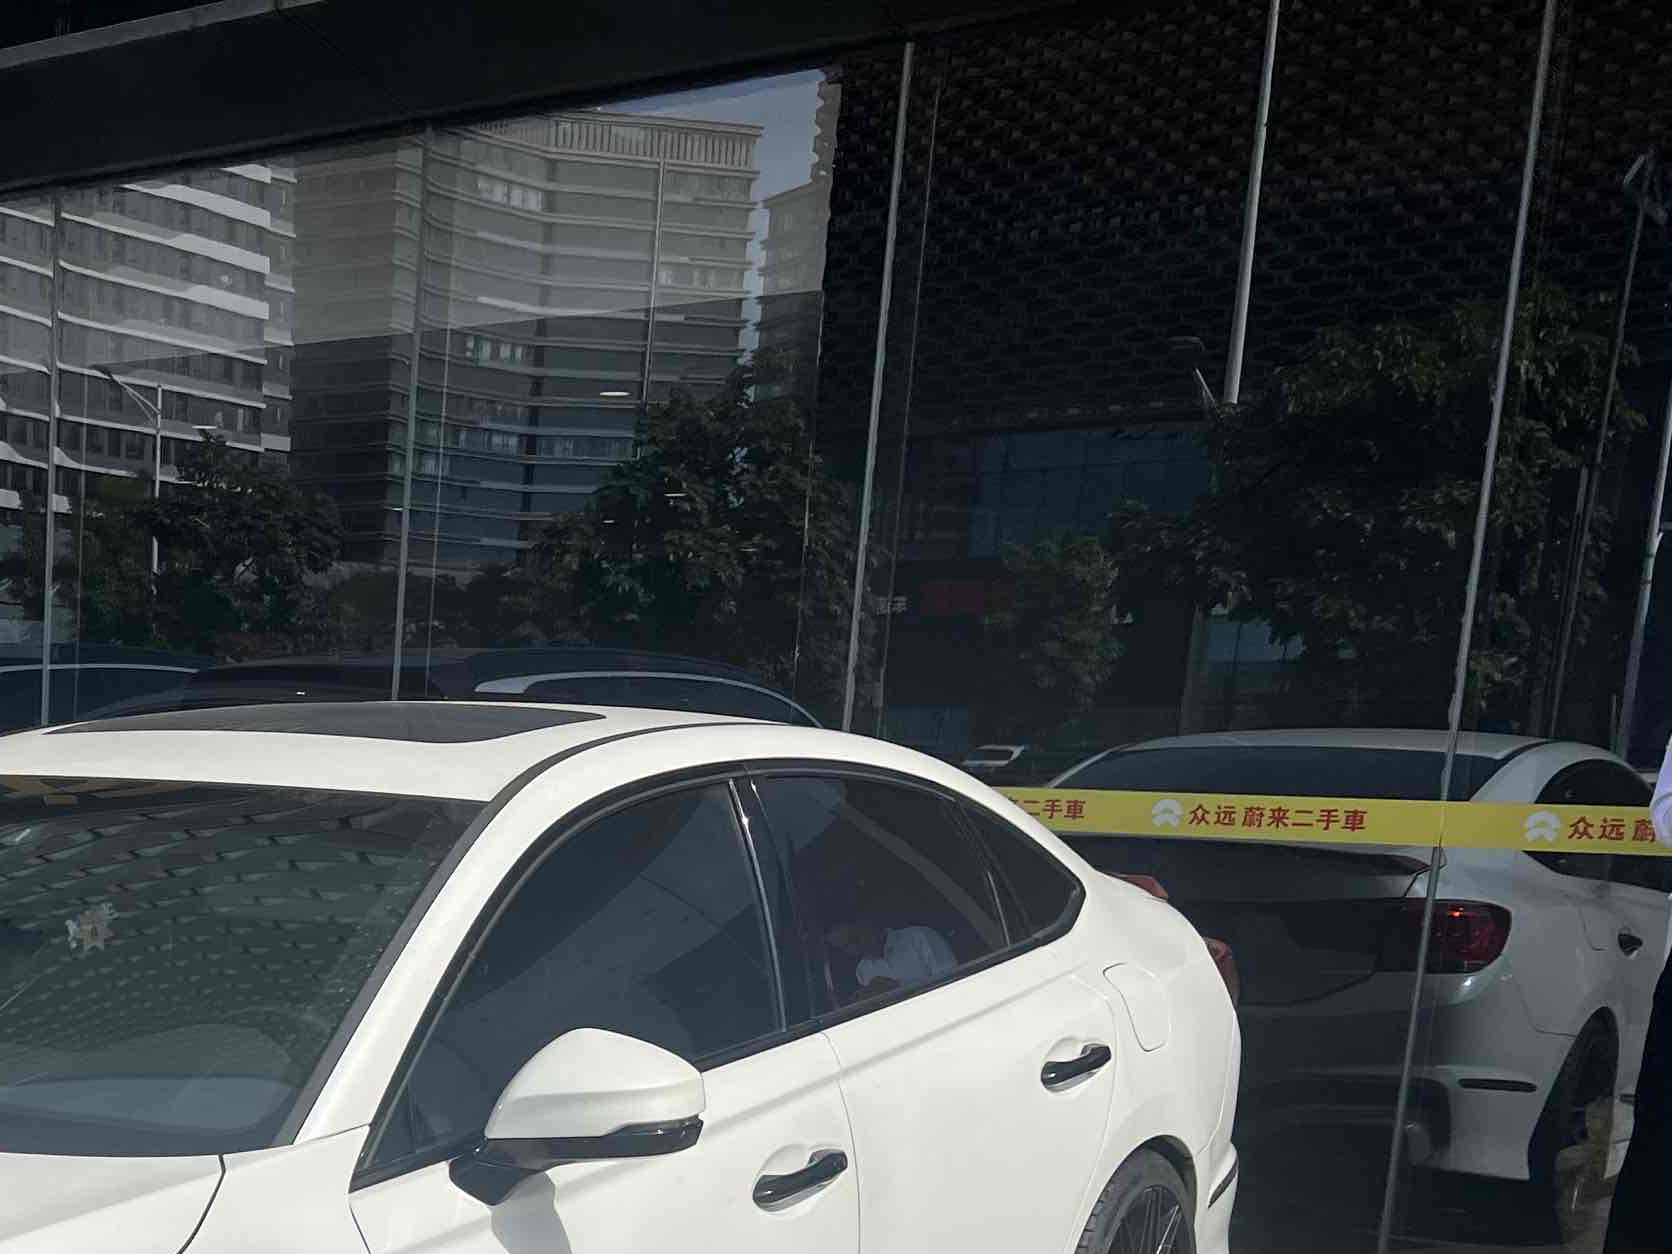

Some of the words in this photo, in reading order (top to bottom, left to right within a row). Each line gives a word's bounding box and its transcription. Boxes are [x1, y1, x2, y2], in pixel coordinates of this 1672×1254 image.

[1009, 797, 1086, 819] 二手車
[1188, 803, 1368, 832] 众远蔚来二手車
